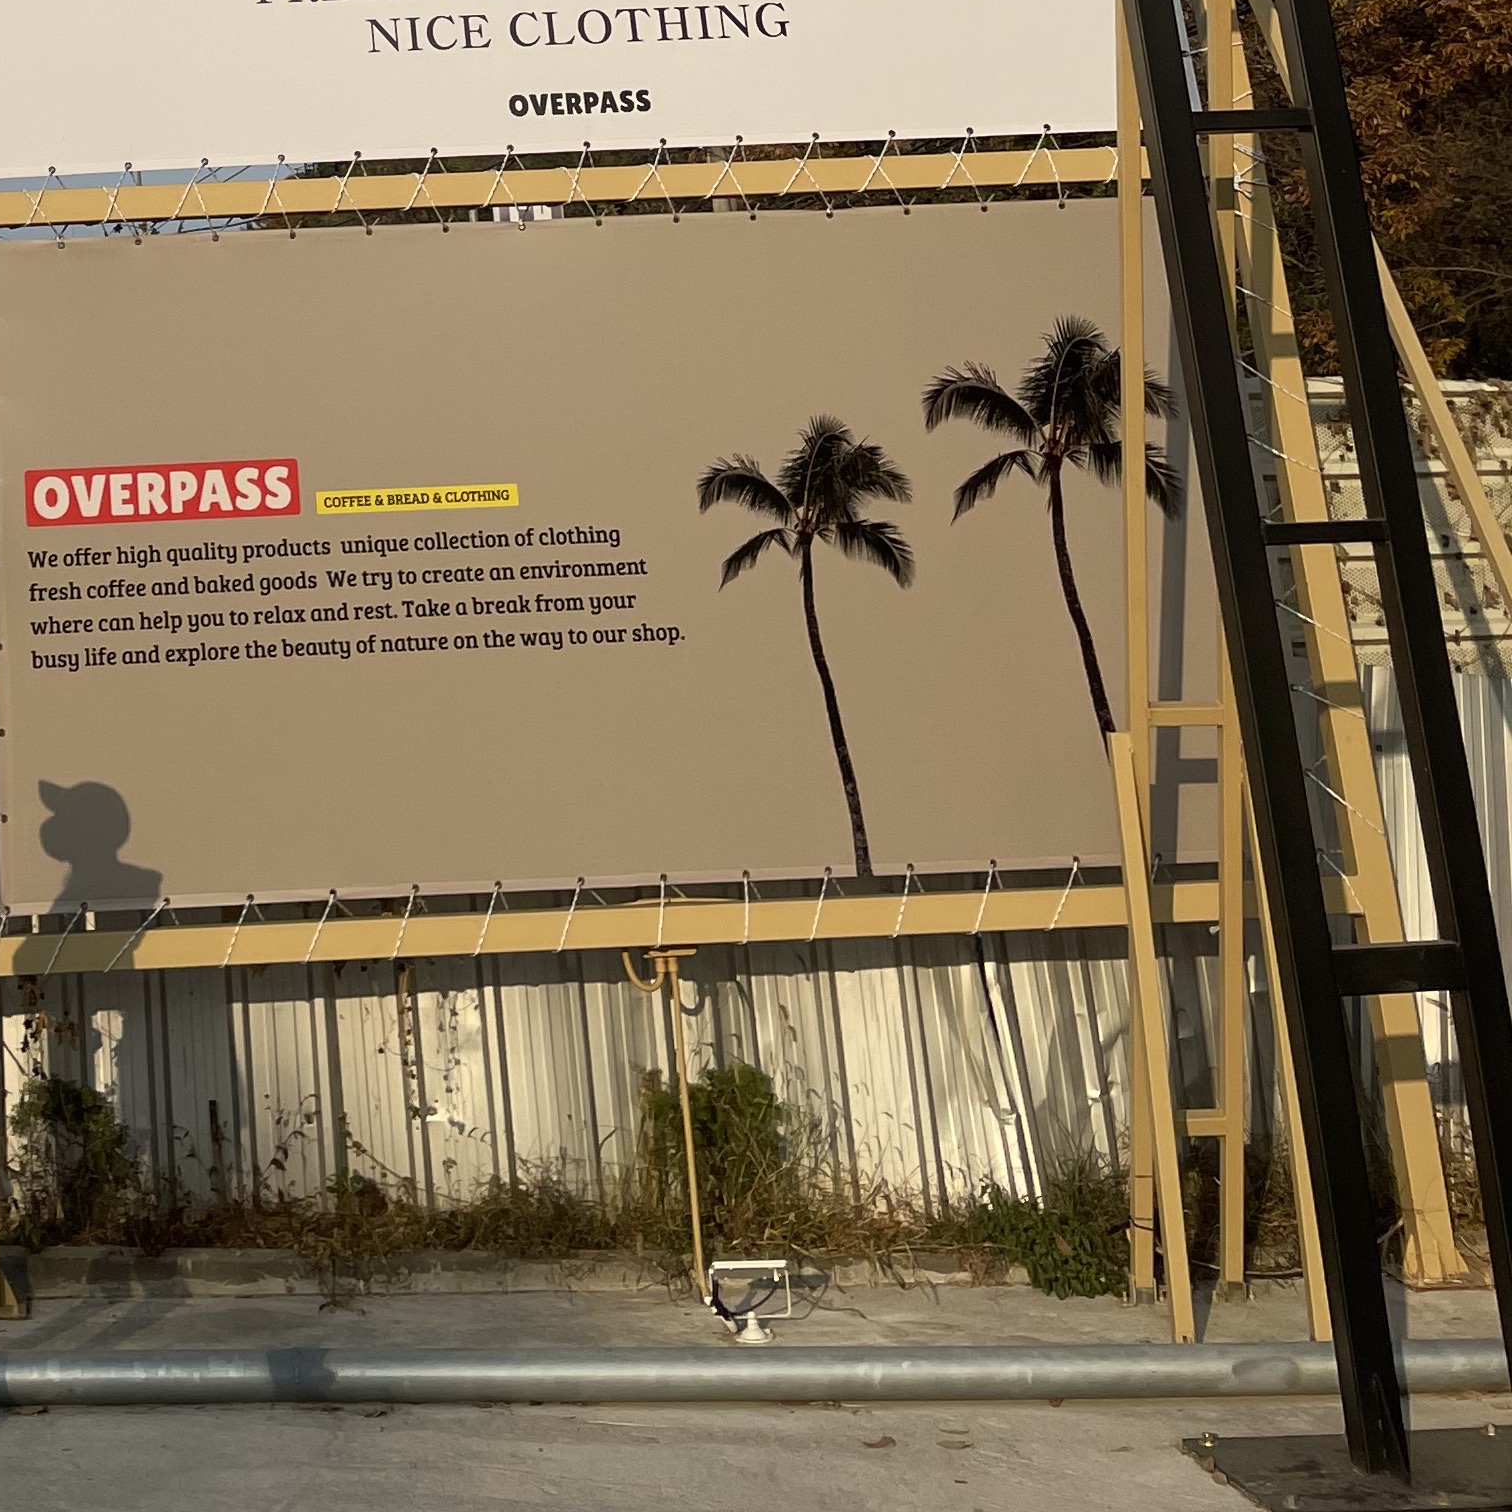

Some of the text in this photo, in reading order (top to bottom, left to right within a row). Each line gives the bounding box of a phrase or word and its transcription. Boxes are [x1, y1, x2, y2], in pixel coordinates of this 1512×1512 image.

[364, 2, 791, 54] NICE CLOTHING
[508, 89, 652, 118] OVERPASS
[33, 465, 292, 520] OVERPASS
[323, 489, 510, 509] COFFEE & BREAD & CLOTHING
[26, 525, 621, 569] We offer high quality products unique collection clothing
[28, 558, 649, 602] fresh coffee and baked goods We try create environment
[29, 593, 637, 636] where can help you relax and rest. Take break from your
[30, 622, 686, 673] busy life and explore the beauty nature the way our shop.
